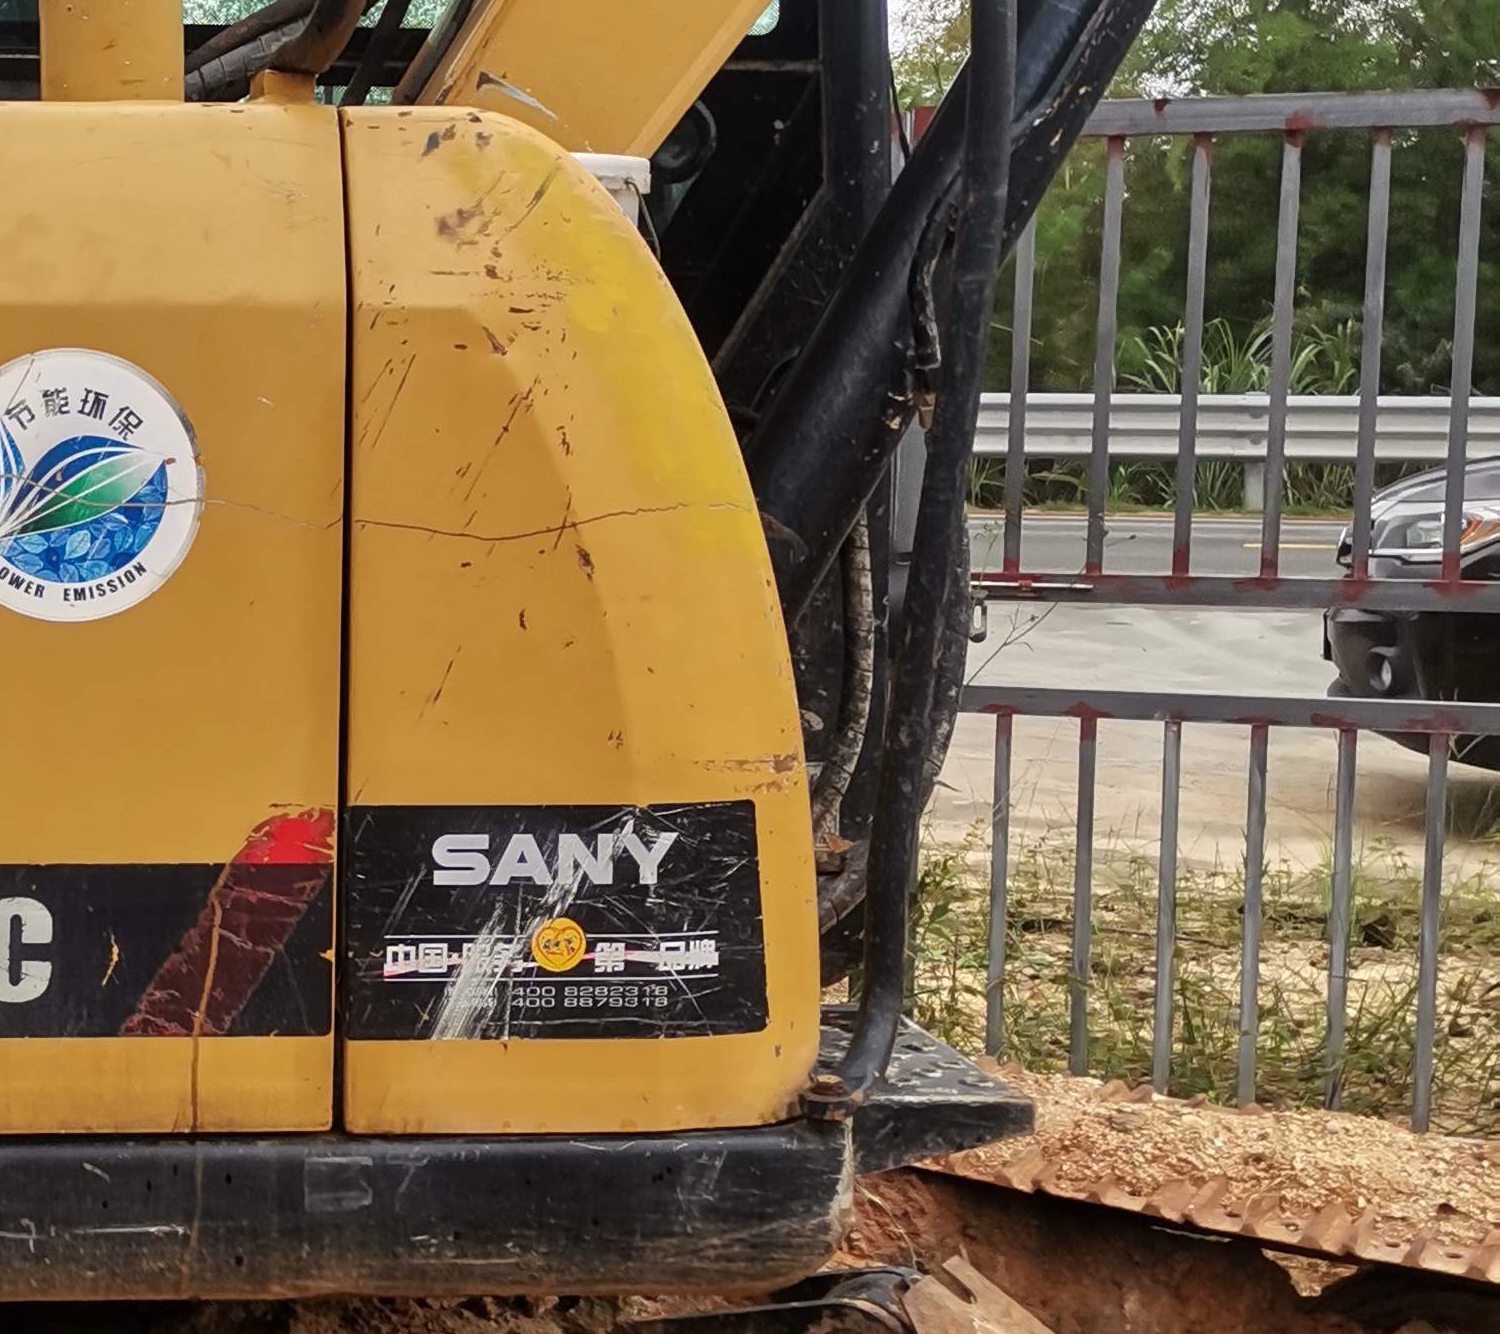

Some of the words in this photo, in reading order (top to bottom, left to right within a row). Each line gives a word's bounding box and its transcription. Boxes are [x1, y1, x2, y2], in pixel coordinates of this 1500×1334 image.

[4, 387, 144, 440] 节能环保
[63, 561, 148, 602] EMISSION
[431, 833, 680, 886] SANY
[511, 986, 556, 997] 400
[511, 997, 556, 1008] 400
